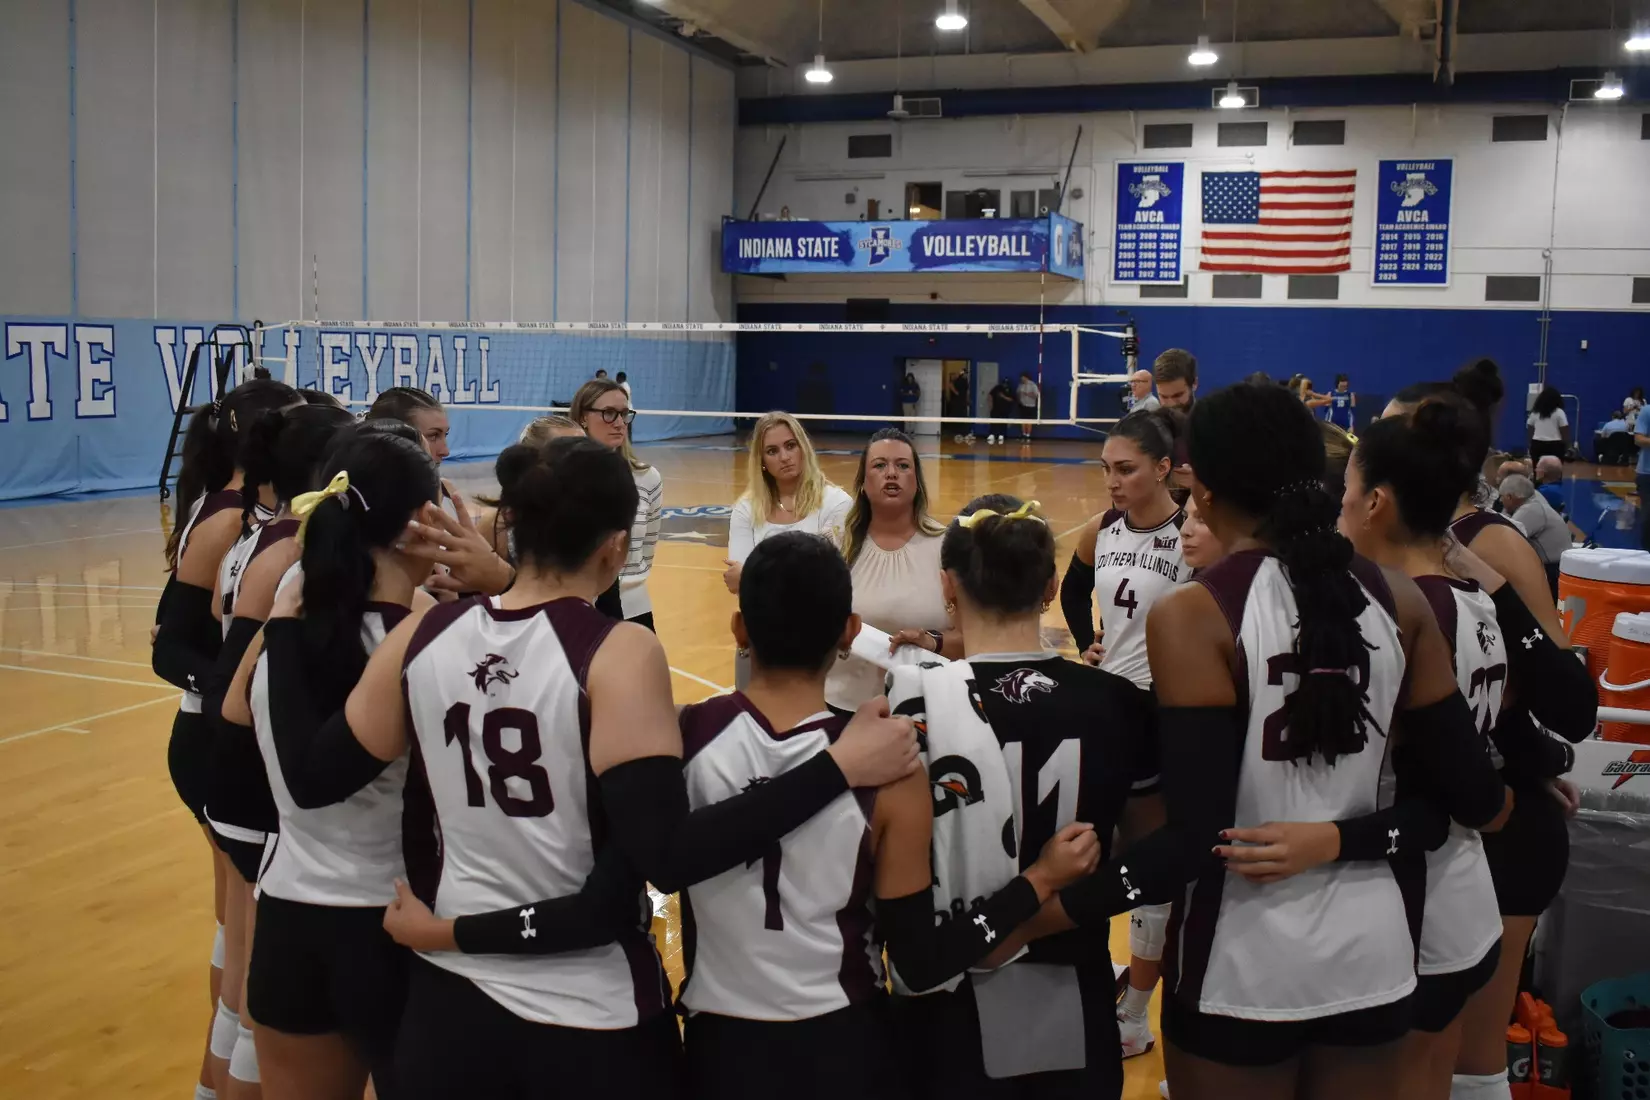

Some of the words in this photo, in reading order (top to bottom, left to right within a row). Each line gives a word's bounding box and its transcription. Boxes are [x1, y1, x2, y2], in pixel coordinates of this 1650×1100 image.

[1134, 211, 1164, 223] AVCA
[1397, 210, 1429, 222] AVCA
[739, 239, 793, 258] INDIANA
[798, 237, 839, 258] STATE
[923, 235, 1031, 257] VOLLEYBALL
[1381, 243, 1398, 251] 2017
[1378, 263, 1398, 271] 2023
[1401, 263, 1420, 271] 2024
[1424, 263, 1443, 271] 2025
[1379, 253, 1398, 261] 2020
[1402, 253, 1420, 261] 2021
[1424, 253, 1444, 261] 2022
[0, 322, 116, 422] TE
[154, 325, 500, 415] VOLEYBALL
[1139, 552, 1179, 583] ILLINOIS
[1114, 578, 1138, 619] 4
[444, 702, 555, 818] 18
